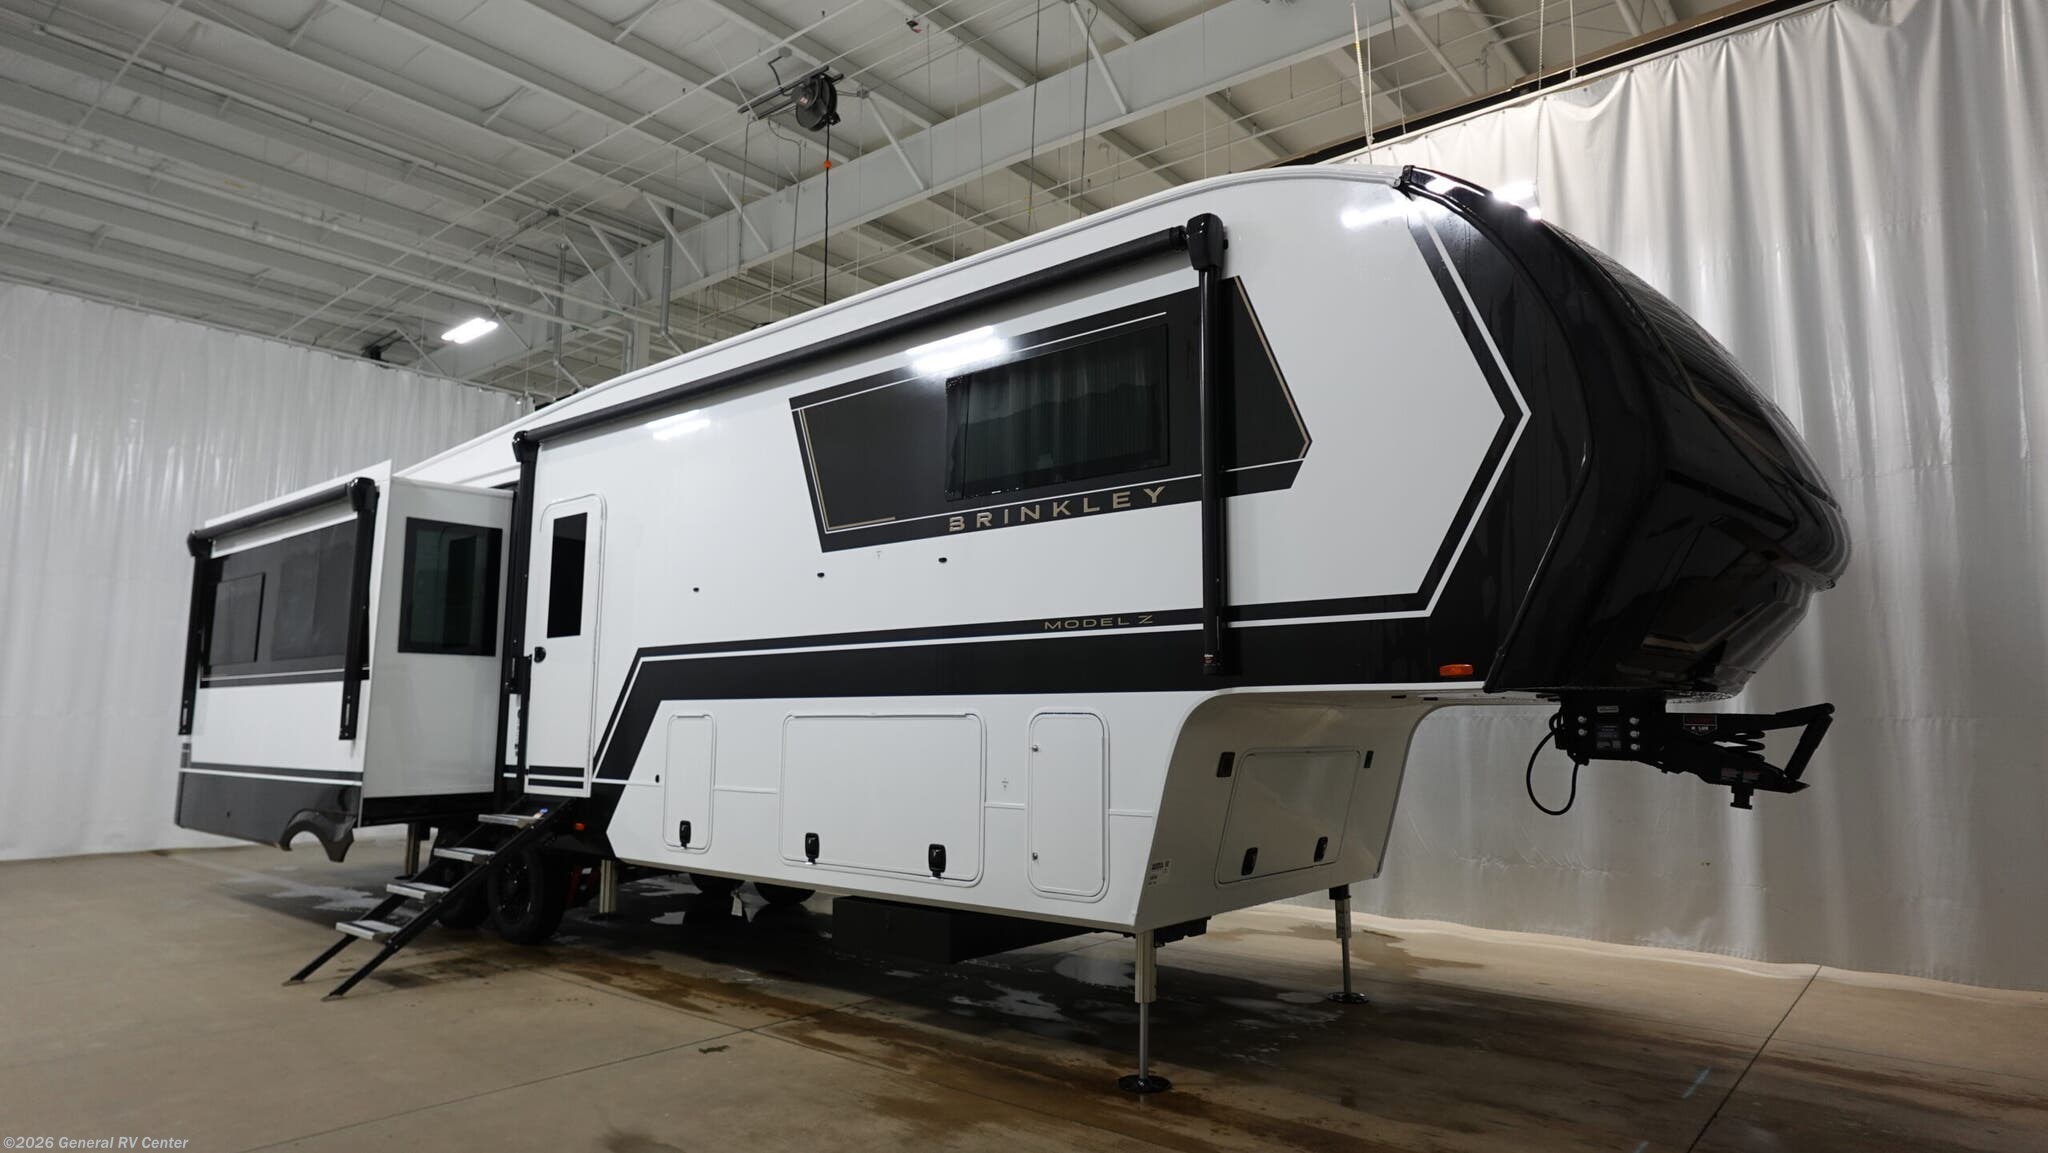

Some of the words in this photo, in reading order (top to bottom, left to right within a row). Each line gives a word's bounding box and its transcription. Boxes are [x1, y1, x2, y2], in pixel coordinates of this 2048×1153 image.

[949, 485, 1166, 532] BRINKLEY
[1044, 616, 1130, 630] MODEL
[1138, 614, 1153, 625] Z
